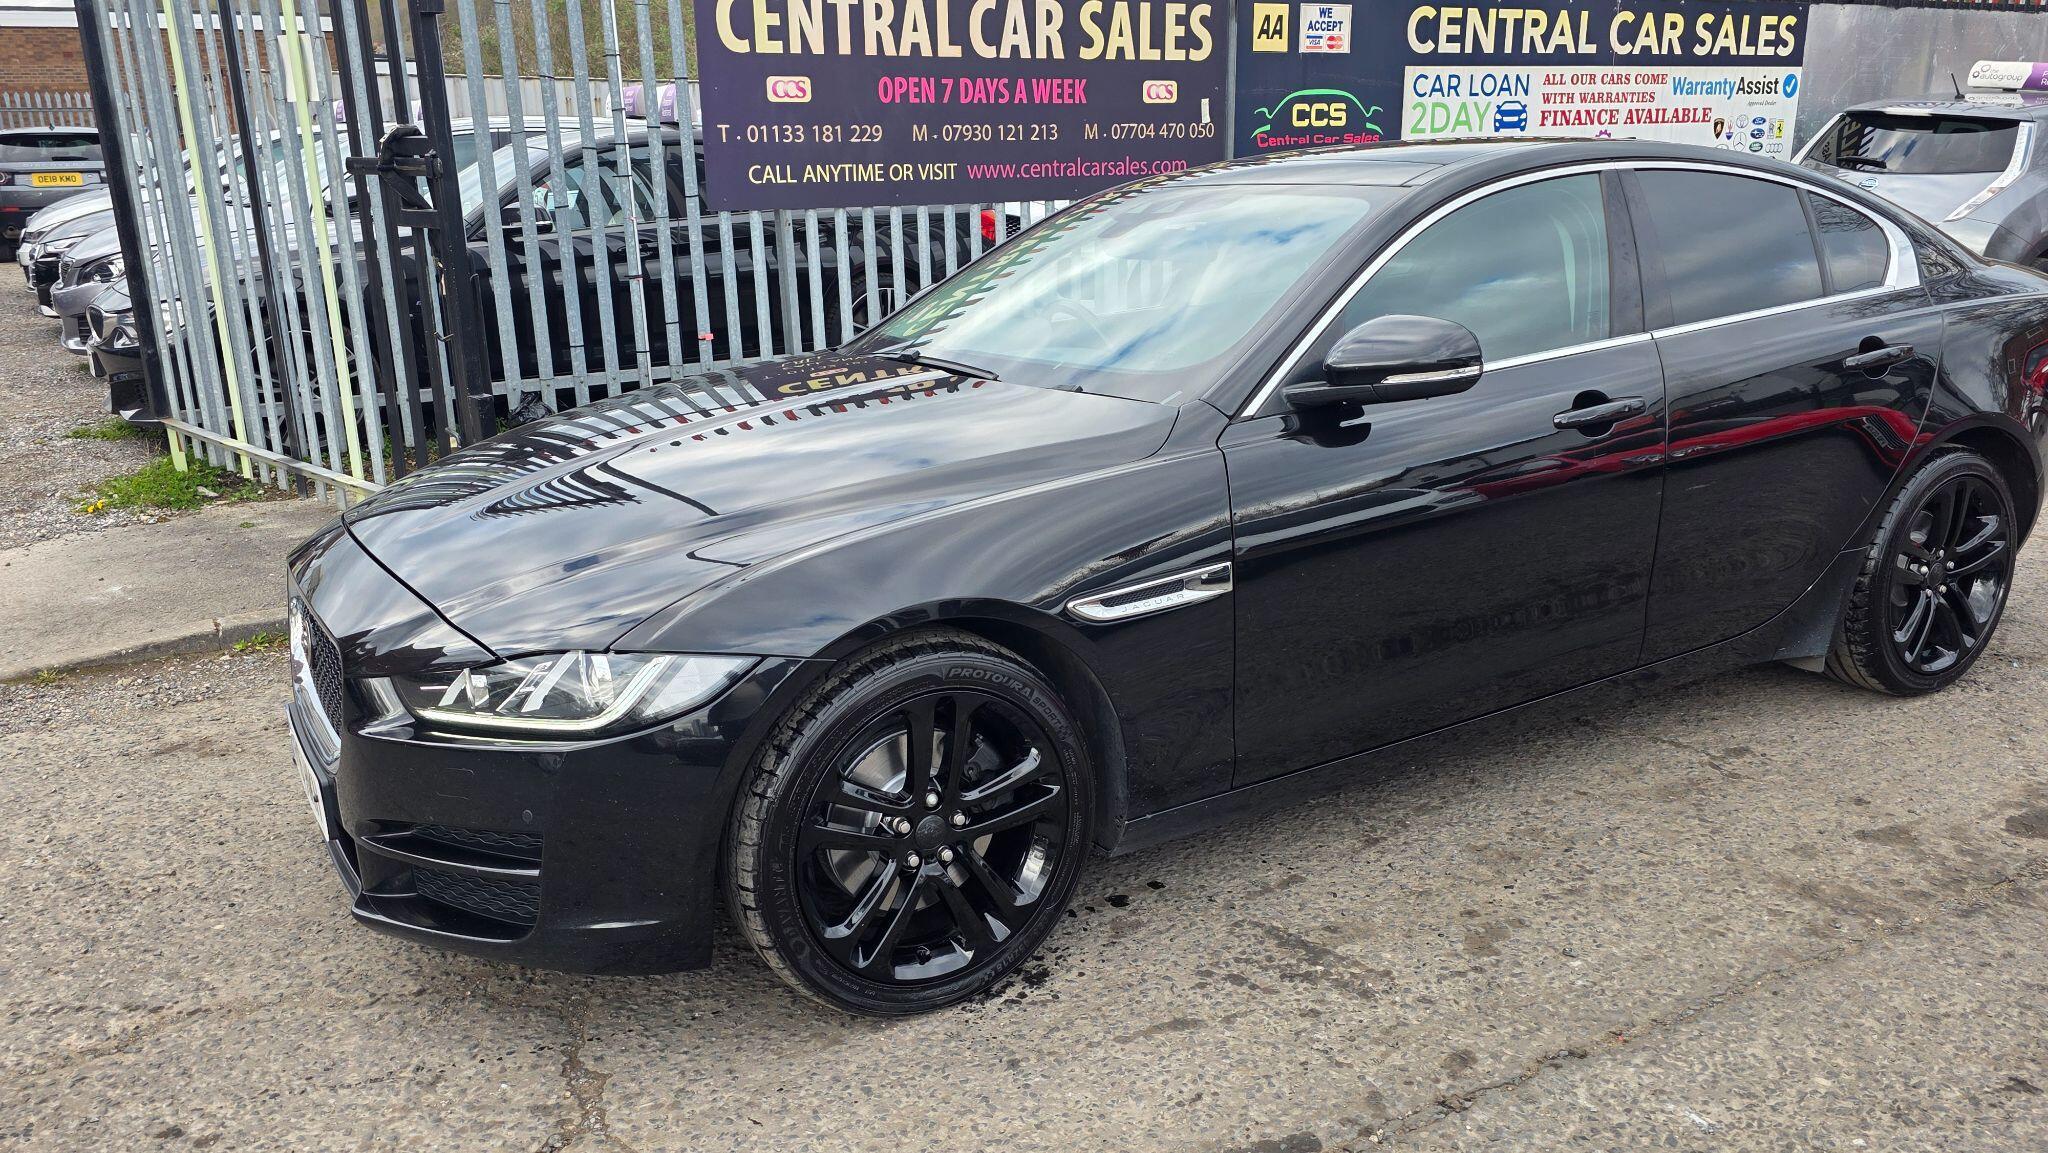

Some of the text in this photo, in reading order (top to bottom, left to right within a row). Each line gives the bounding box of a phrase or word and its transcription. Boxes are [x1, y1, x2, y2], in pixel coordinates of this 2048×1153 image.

[1319, 7, 1333, 19] WE
[715, 0, 1213, 62] CENTRAL CAR SALES
[1257, 14, 1284, 40] AA
[1307, 21, 1343, 32] ACCEPT
[1407, 5, 1798, 57] CENTRAL CAR SALES
[1413, 73, 1530, 98] CAR LOAN
[1543, 73, 1668, 86] ALL OUR CARS COME
[1979, 73, 2022, 81] autogroup
[878, 76, 1087, 104] OPEN 7 DAYS A WEEK
[1542, 91, 1656, 105] WITH WARRANTIES
[1292, 103, 1347, 127] CCS
[1410, 101, 1492, 134] 2DAY
[1539, 107, 1713, 127] FINANCE AVAILABLE
[746, 124, 805, 143] 01133
[812, 124, 842, 143] 181
[850, 124, 883, 143] 229
[942, 124, 992, 142] 07930
[998, 124, 1024, 141] 121
[1030, 124, 1058, 141] 213
[1111, 123, 1155, 140] 07704
[1159, 122, 1185, 140] 470
[1189, 122, 1215, 139] 050
[1256, 132, 1380, 147] Central Car Sales
[748, 155, 1188, 184] CALL ANYTIME OR VISIT www.centralcarsales.com
[1121, 593, 1185, 613] JAGUAR
[949, 668, 1034, 700] PROTOURA
[1031, 695, 1062, 727] SPORT
